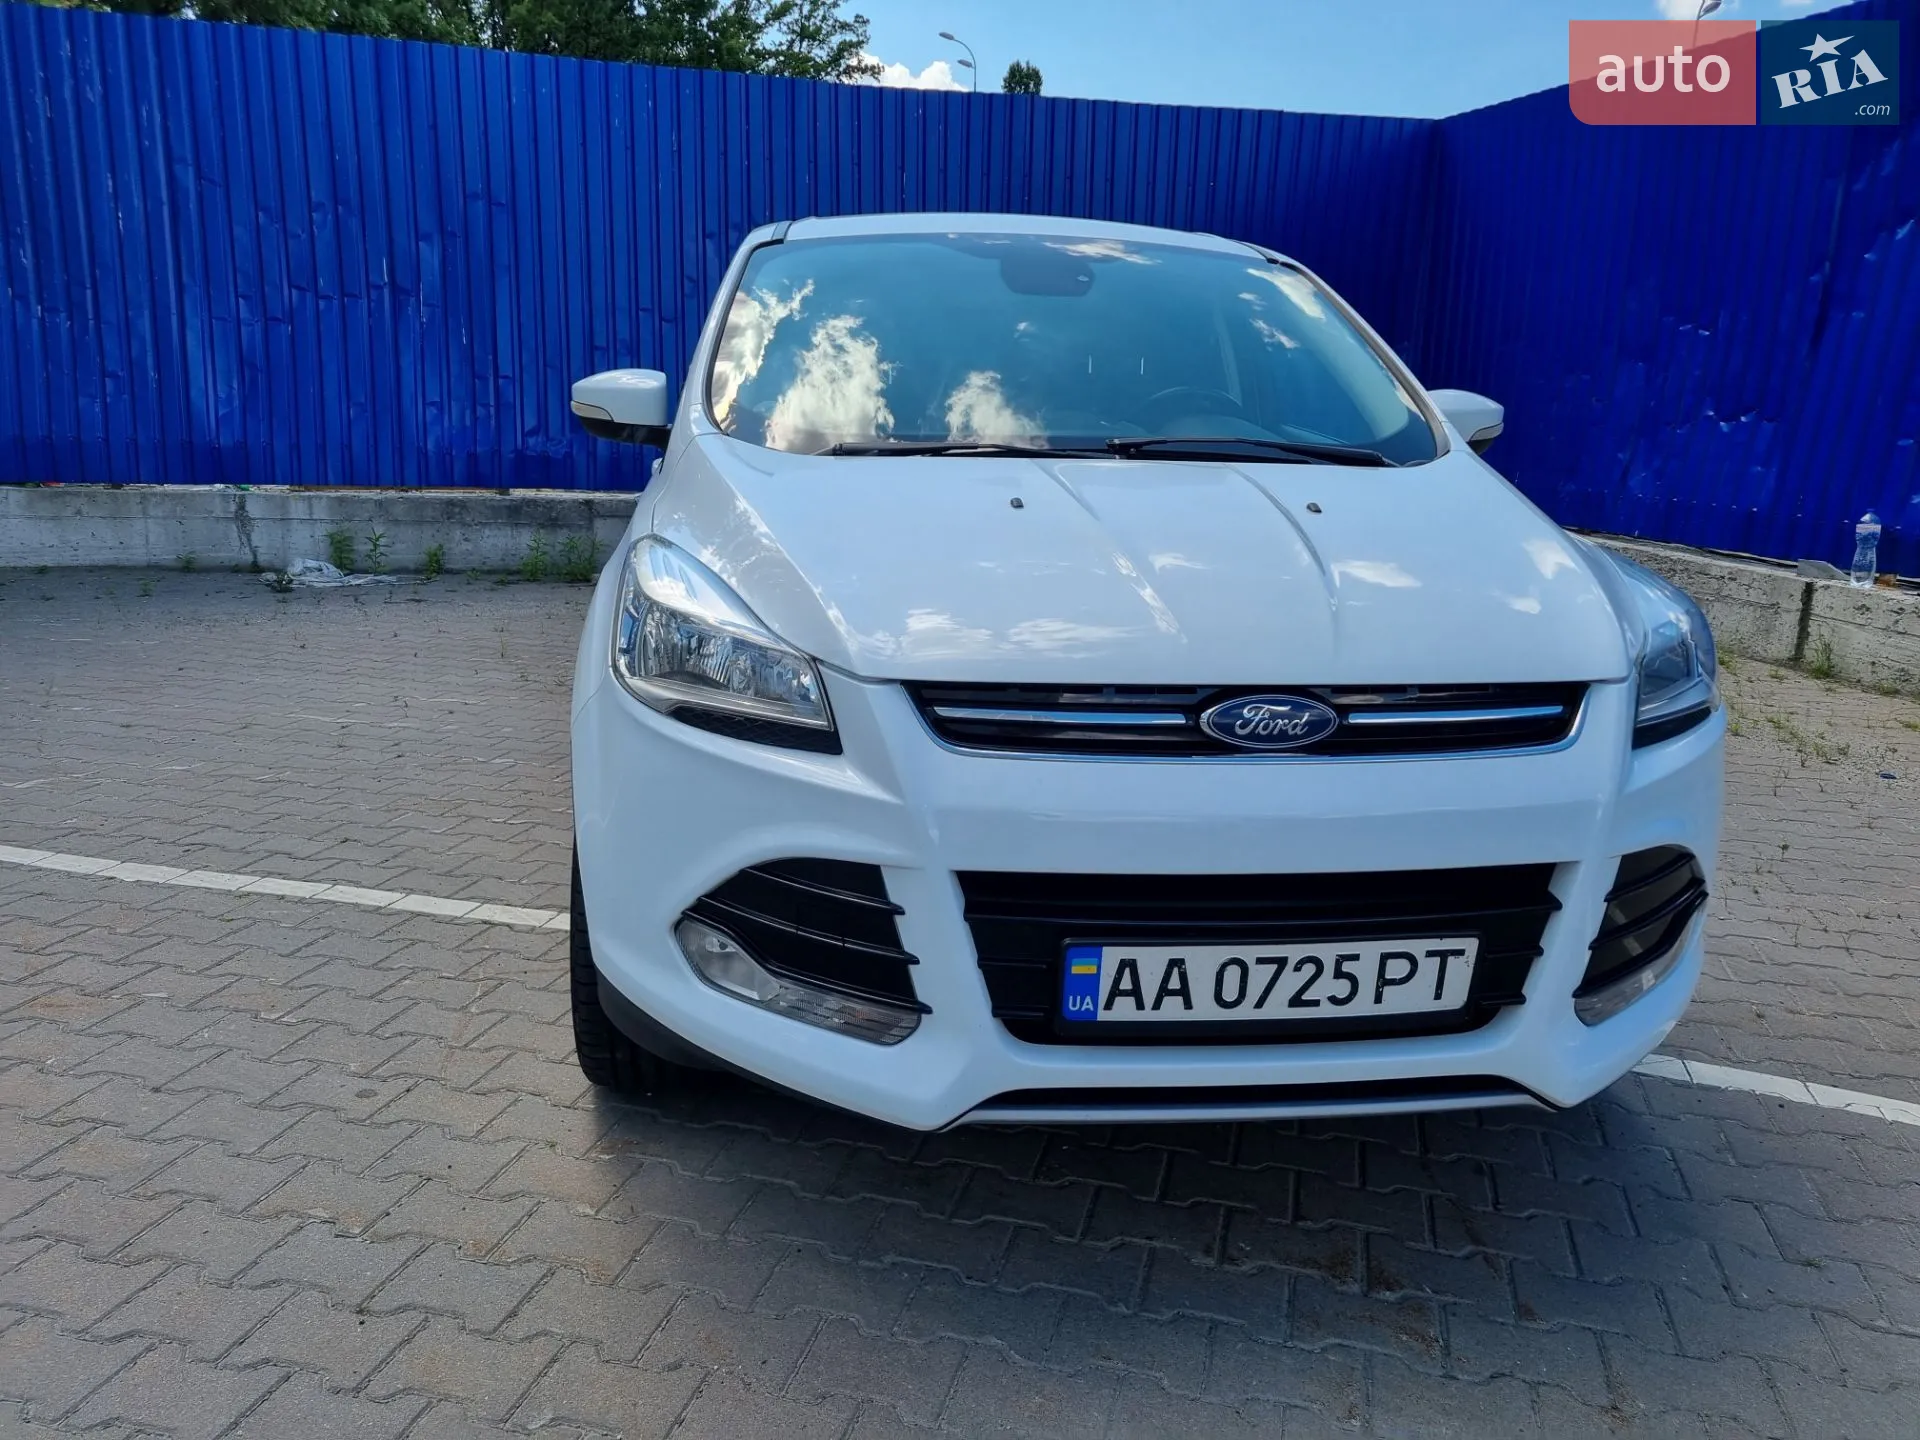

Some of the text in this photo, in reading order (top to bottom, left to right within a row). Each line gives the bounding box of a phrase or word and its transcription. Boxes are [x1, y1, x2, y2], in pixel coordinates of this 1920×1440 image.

[1234, 703, 1310, 735] Ford
[1103, 949, 1466, 1010] AA 0725 PT
[1068, 995, 1094, 1011] UA
